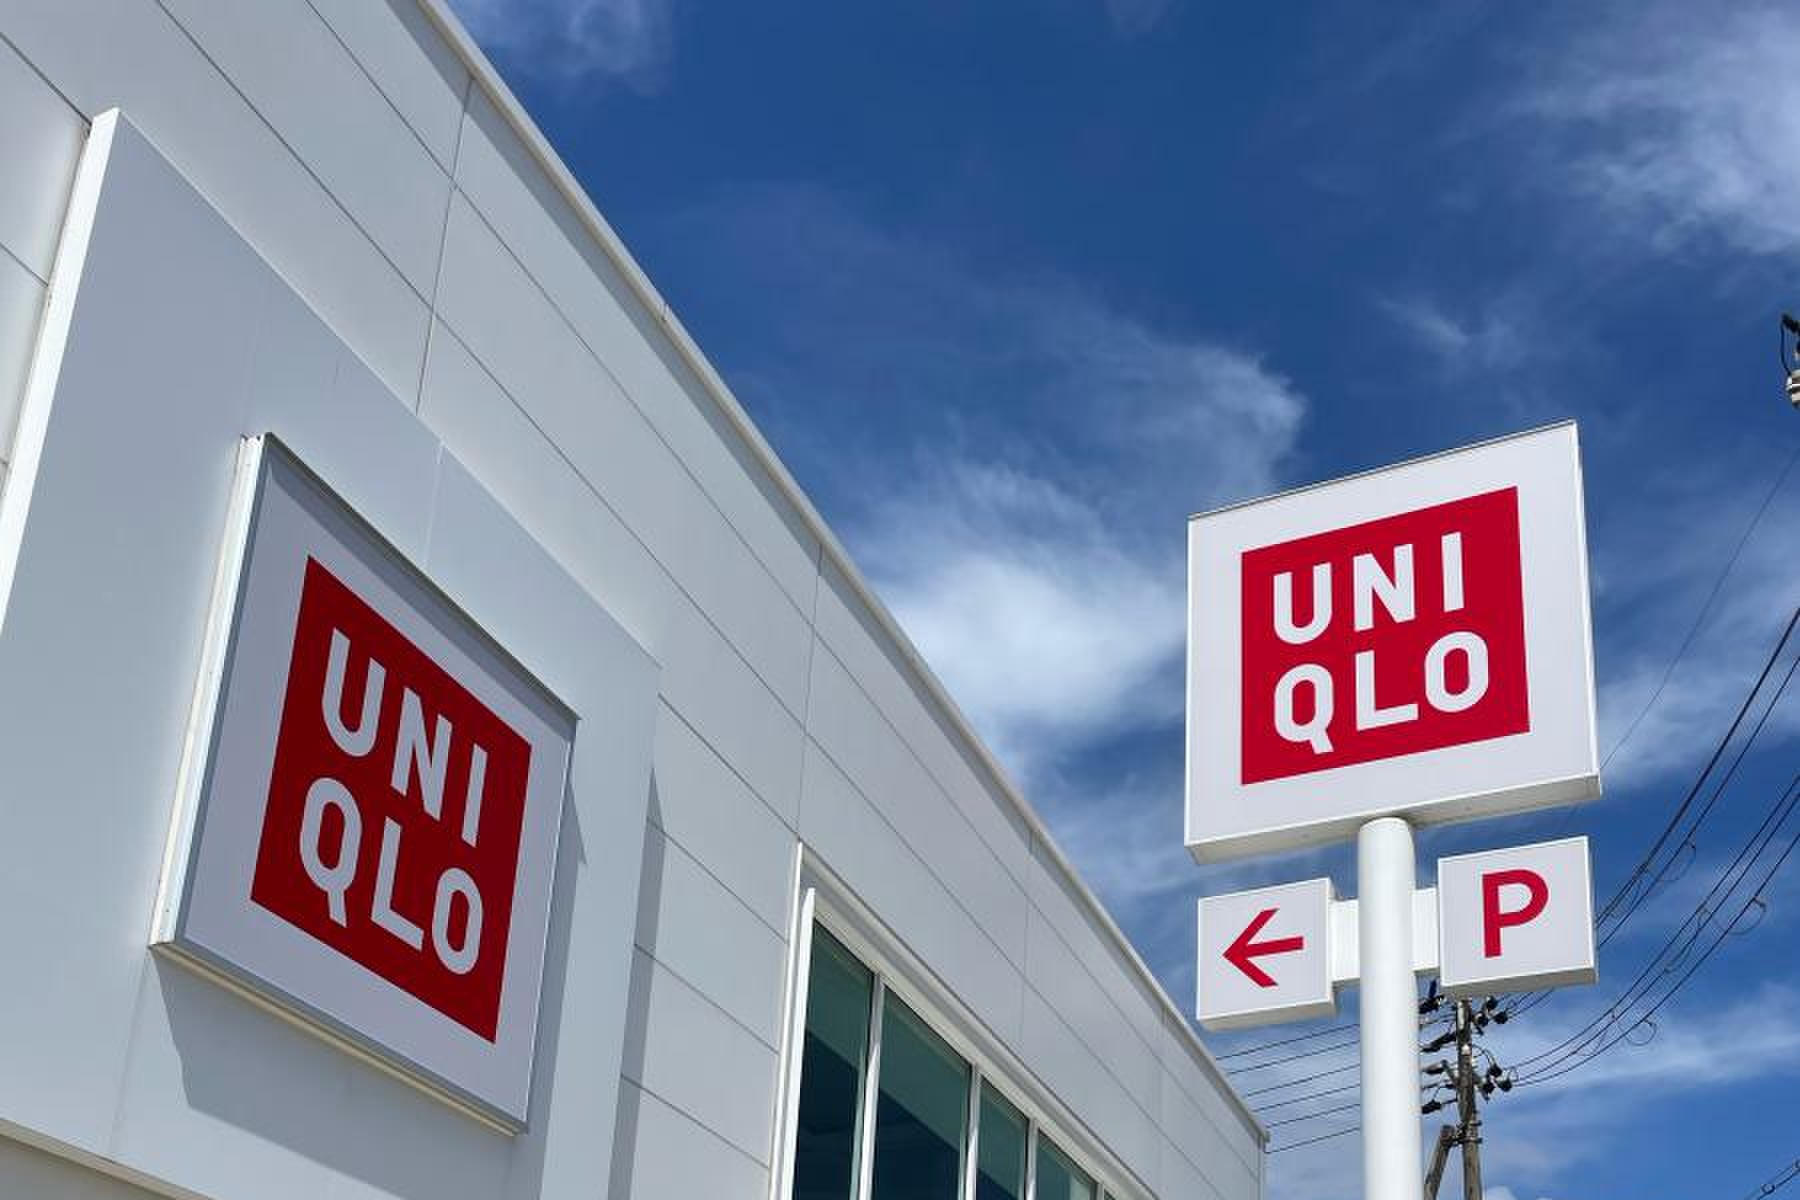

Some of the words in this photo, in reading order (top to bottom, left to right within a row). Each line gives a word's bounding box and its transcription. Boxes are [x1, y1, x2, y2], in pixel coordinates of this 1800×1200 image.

[1273, 531, 1465, 645] UNI
[322, 628, 487, 847] UNI
[1274, 631, 1489, 755] QLO
[300, 777, 484, 975] QLO
[1482, 869, 1549, 959] P
